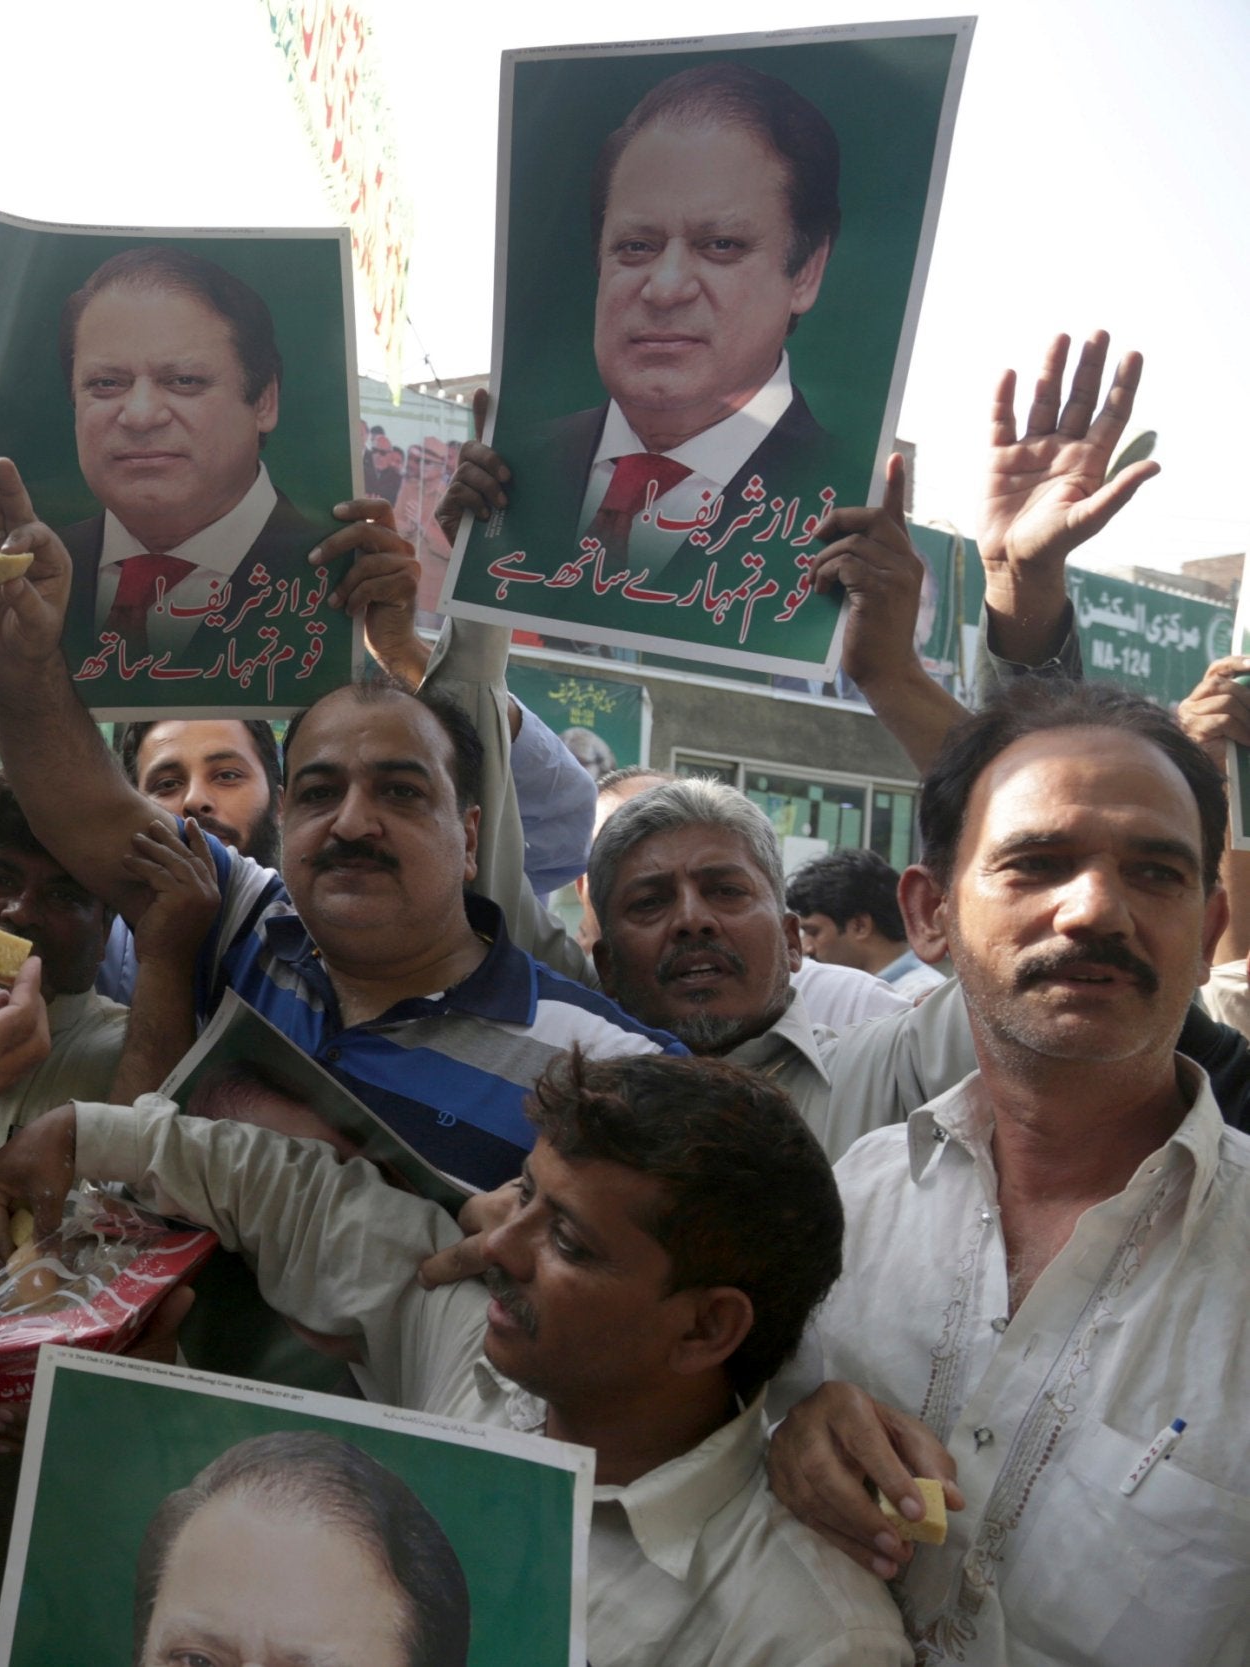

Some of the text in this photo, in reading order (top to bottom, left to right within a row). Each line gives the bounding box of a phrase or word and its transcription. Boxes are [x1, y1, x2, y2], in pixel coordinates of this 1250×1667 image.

[753, 486, 835, 547] نواز
[266, 567, 329, 618] نواز
[488, 537, 818, 644] قوم تمہارے ساتھ ہے
[73, 621, 328, 701] قوم تمہارے ساتھ
[1092, 639, 1151, 678] NA-124
